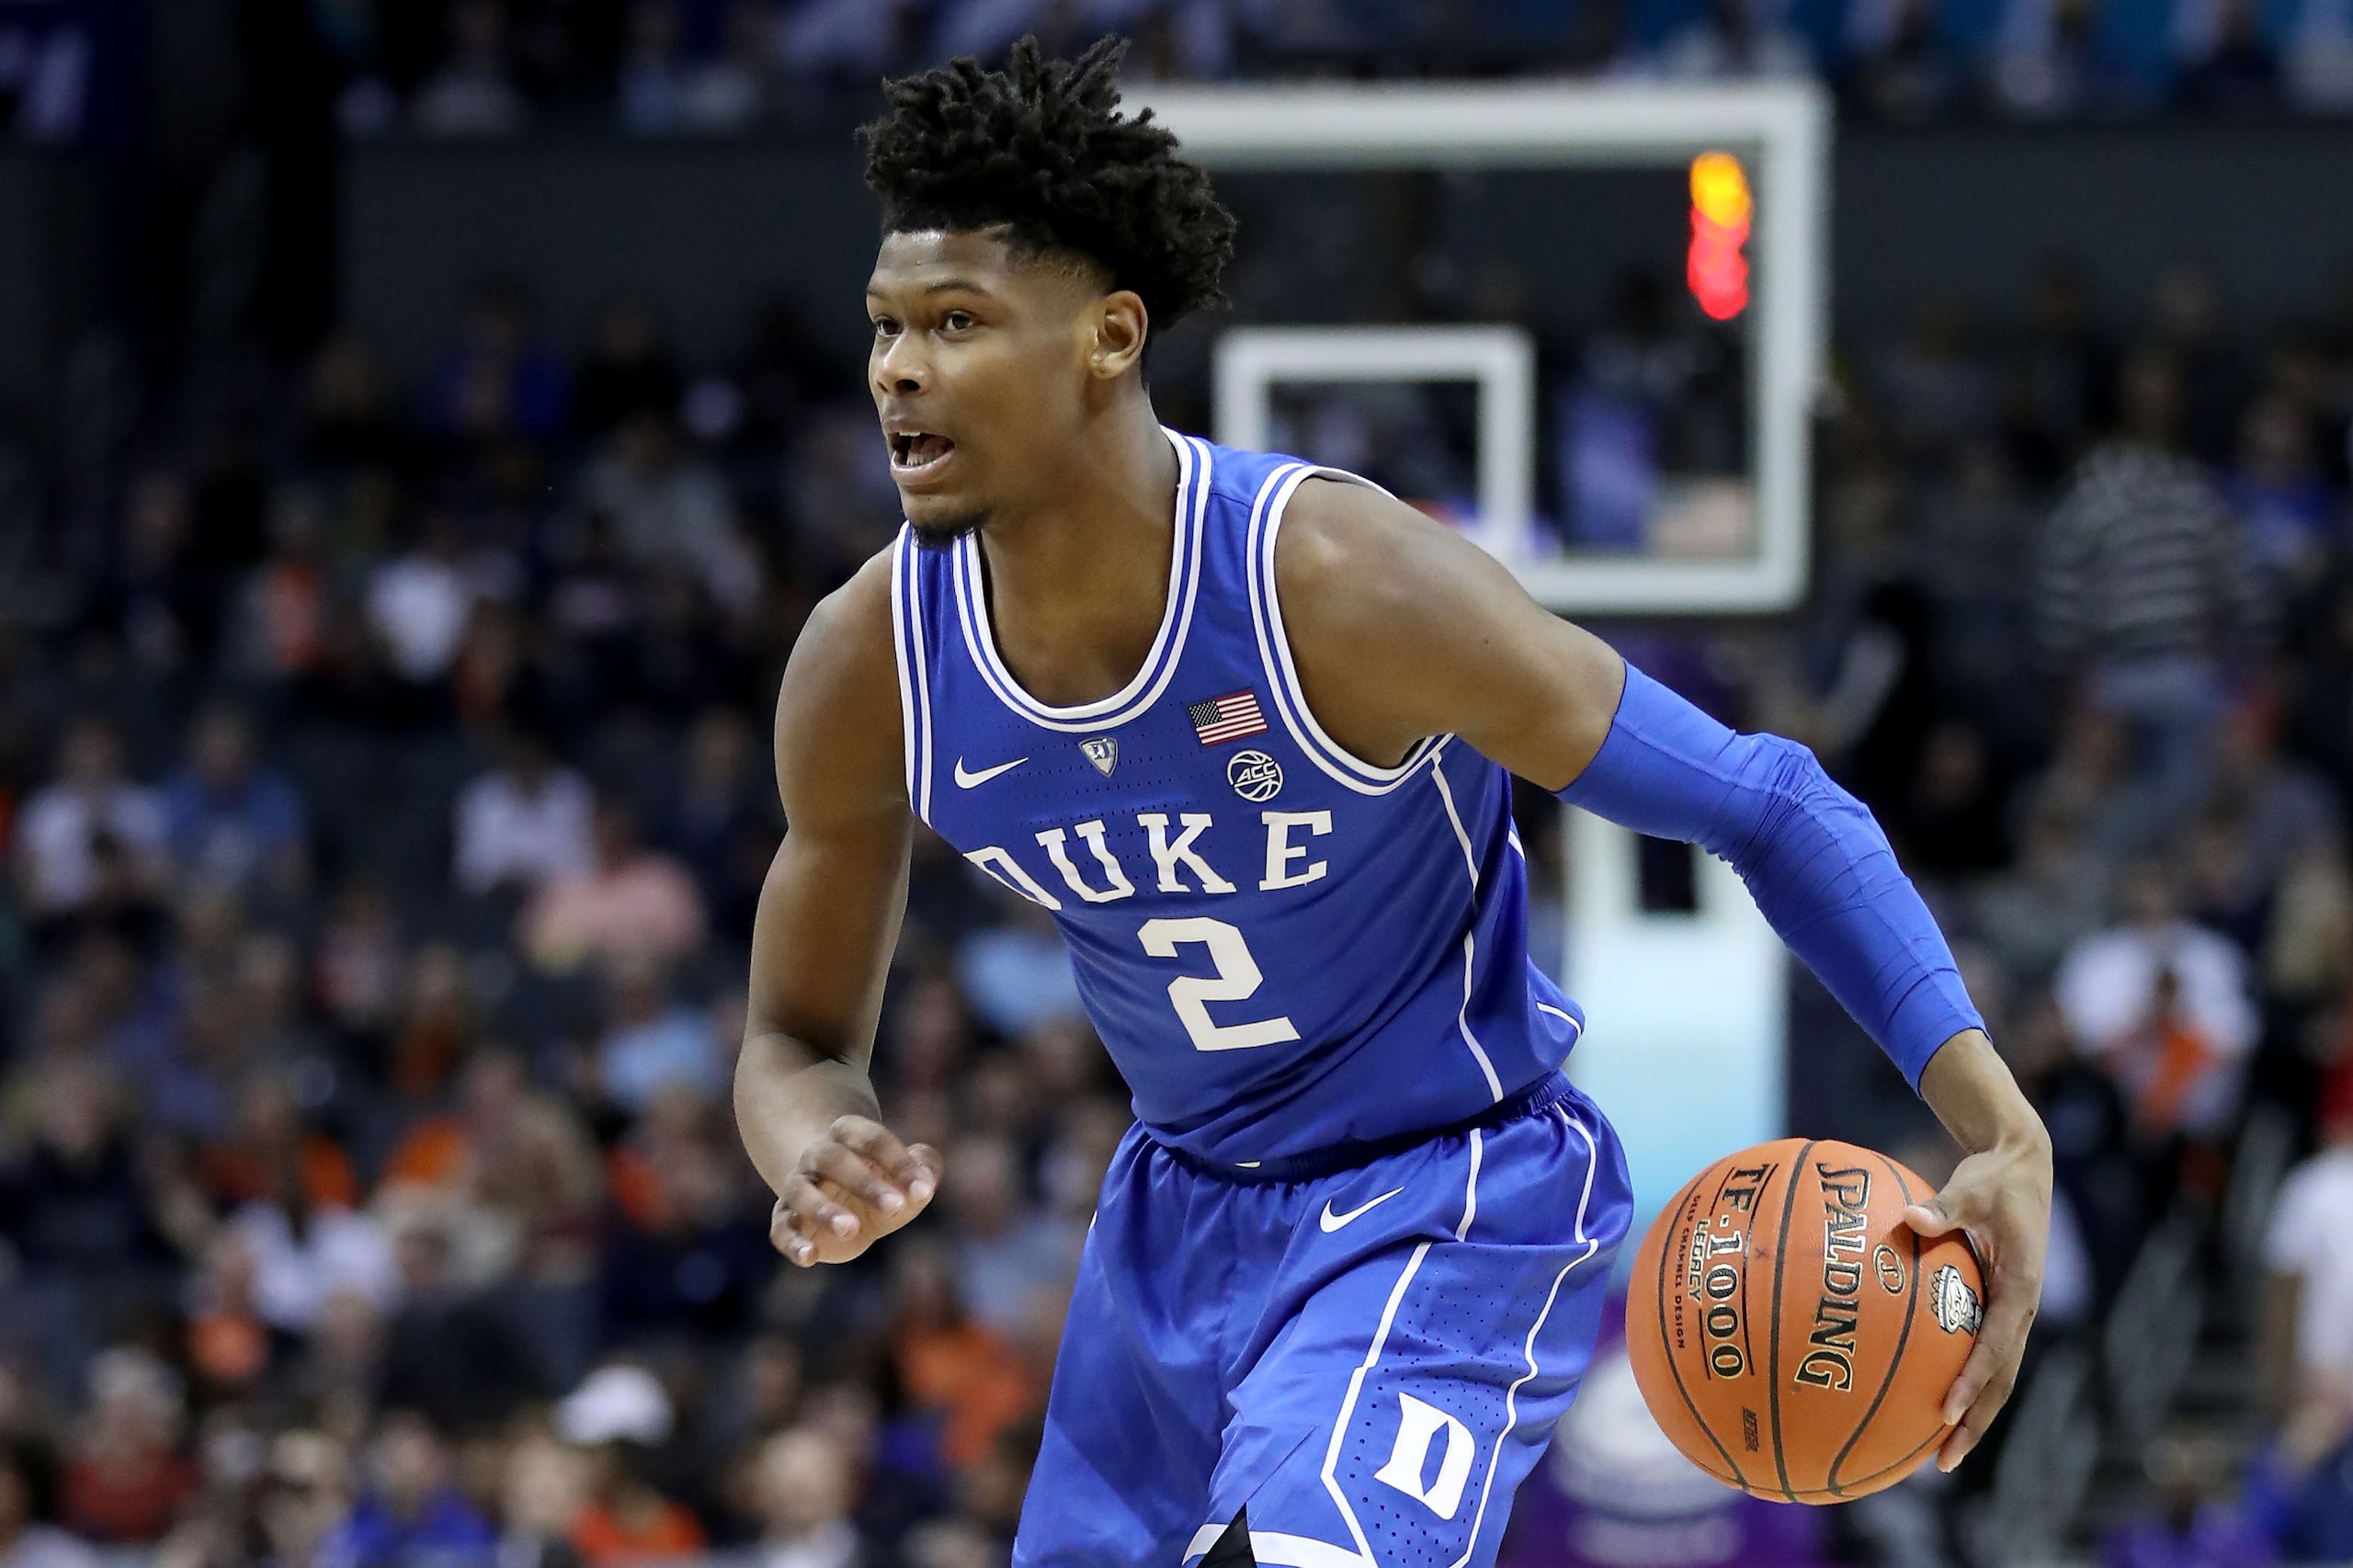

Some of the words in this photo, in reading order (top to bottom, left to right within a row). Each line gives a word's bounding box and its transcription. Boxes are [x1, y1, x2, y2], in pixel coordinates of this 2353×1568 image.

[1235, 760, 1277, 784] ACC
[962, 810, 1333, 911] DUKE
[1137, 917, 1302, 1051] 2
[1675, 1228, 1690, 1289] CHANNEL
[1688, 1219, 1711, 1307] LEGACY
[1704, 1163, 1770, 1380] TF-1000
[1794, 1162, 1872, 1393] SPALDING
[1675, 1295, 1687, 1349] DESIGN
[1373, 1391, 1475, 1520] D
